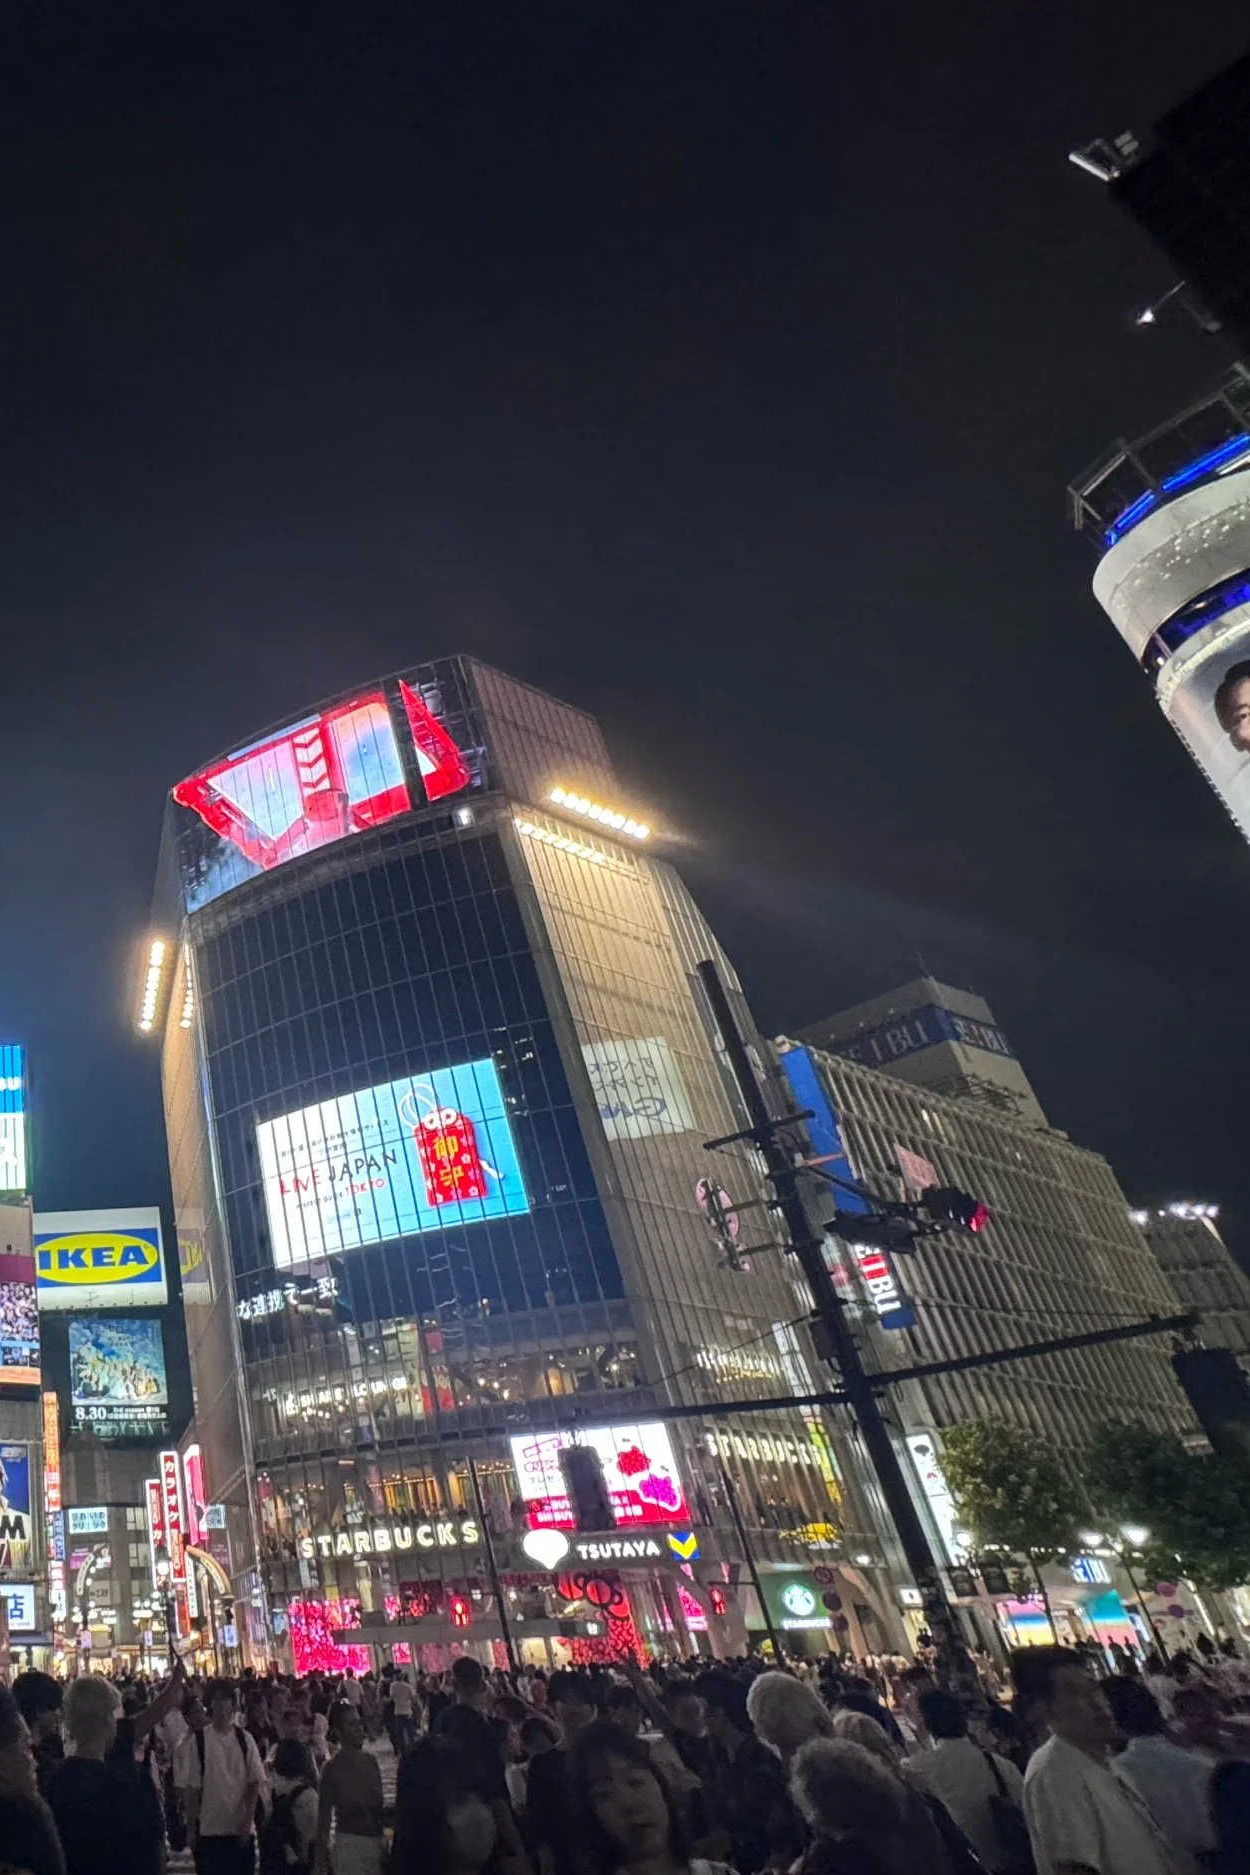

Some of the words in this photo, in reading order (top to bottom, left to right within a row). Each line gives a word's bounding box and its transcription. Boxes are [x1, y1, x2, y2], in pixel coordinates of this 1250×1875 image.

[328, 1148, 398, 1182] JAPAN
[38, 1245, 150, 1271] IKEA
[75, 1406, 107, 1420] 8.30
[164, 1459, 178, 1520] カラオケ
[301, 1521, 479, 1559] STARBUCKS
[577, 1540, 661, 1560] TSUTAYA
